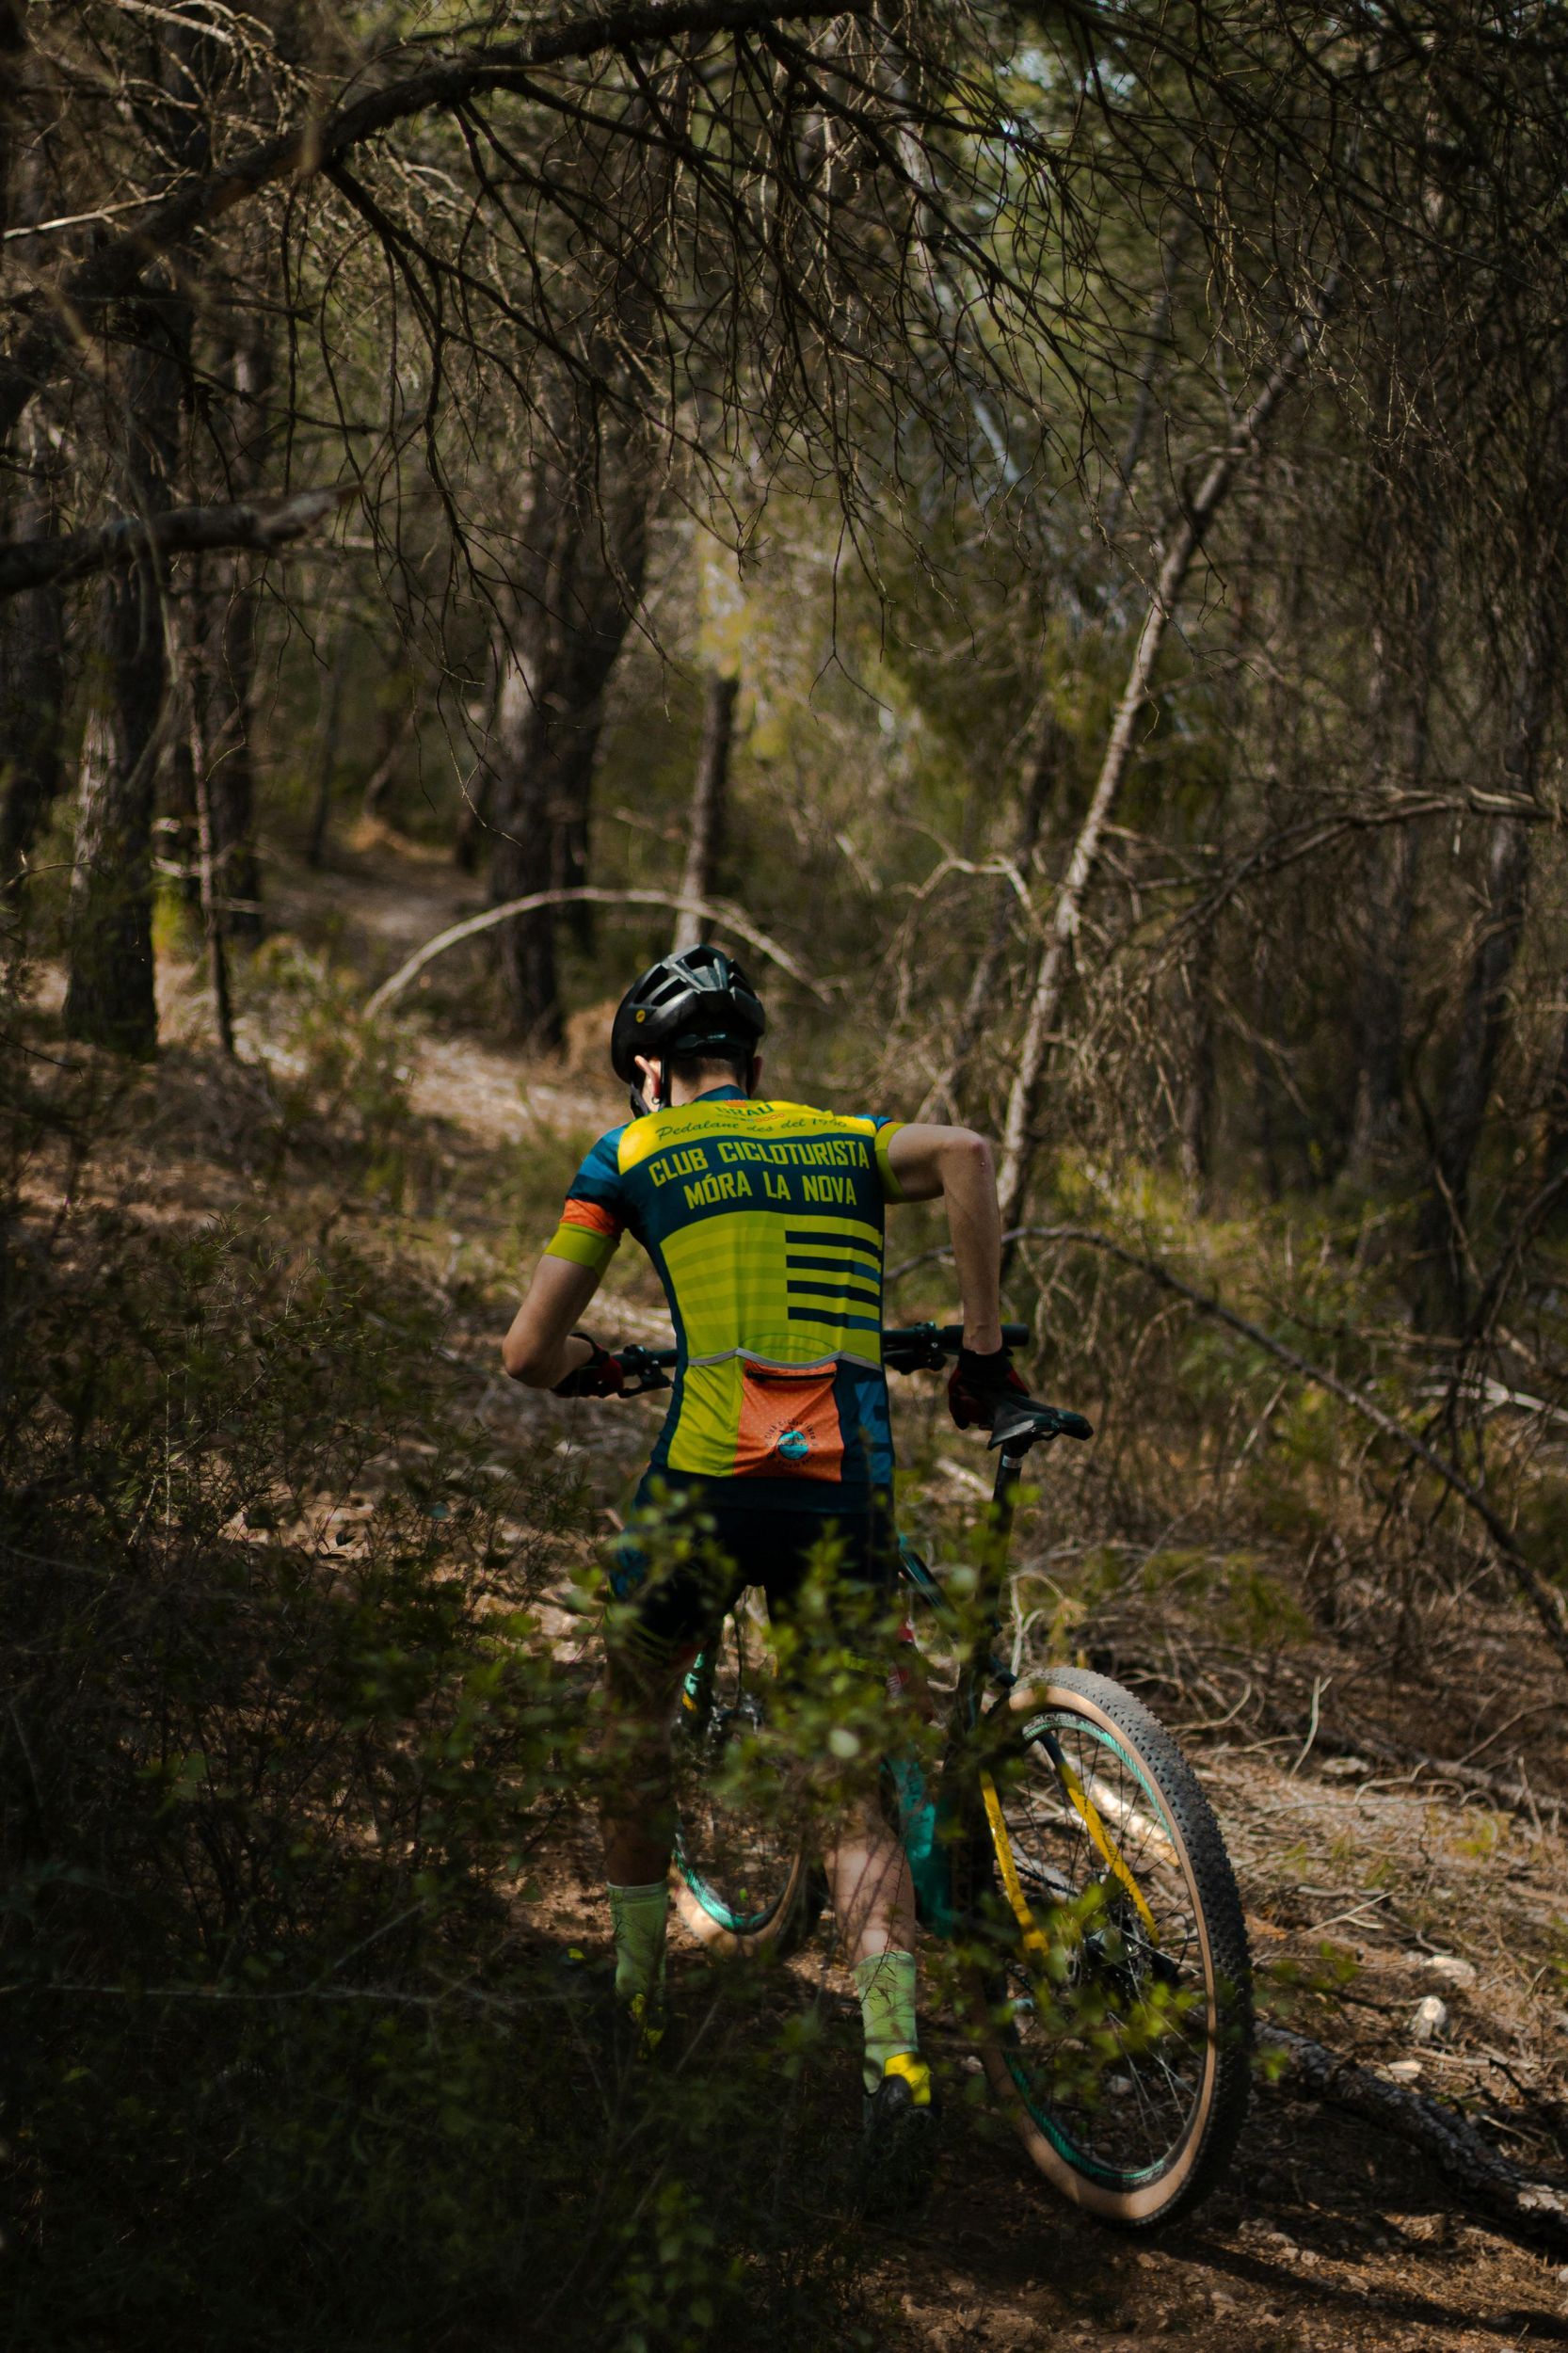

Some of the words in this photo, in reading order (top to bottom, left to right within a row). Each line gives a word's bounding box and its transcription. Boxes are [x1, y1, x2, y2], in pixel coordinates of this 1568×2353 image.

[648, 1147, 709, 1187] CLUB
[717, 1140, 871, 1169] CICLOTURISTA
[683, 1170, 753, 1210] MÓRA
[762, 1171, 792, 1201] LA
[802, 1175, 857, 1206] NOVA
